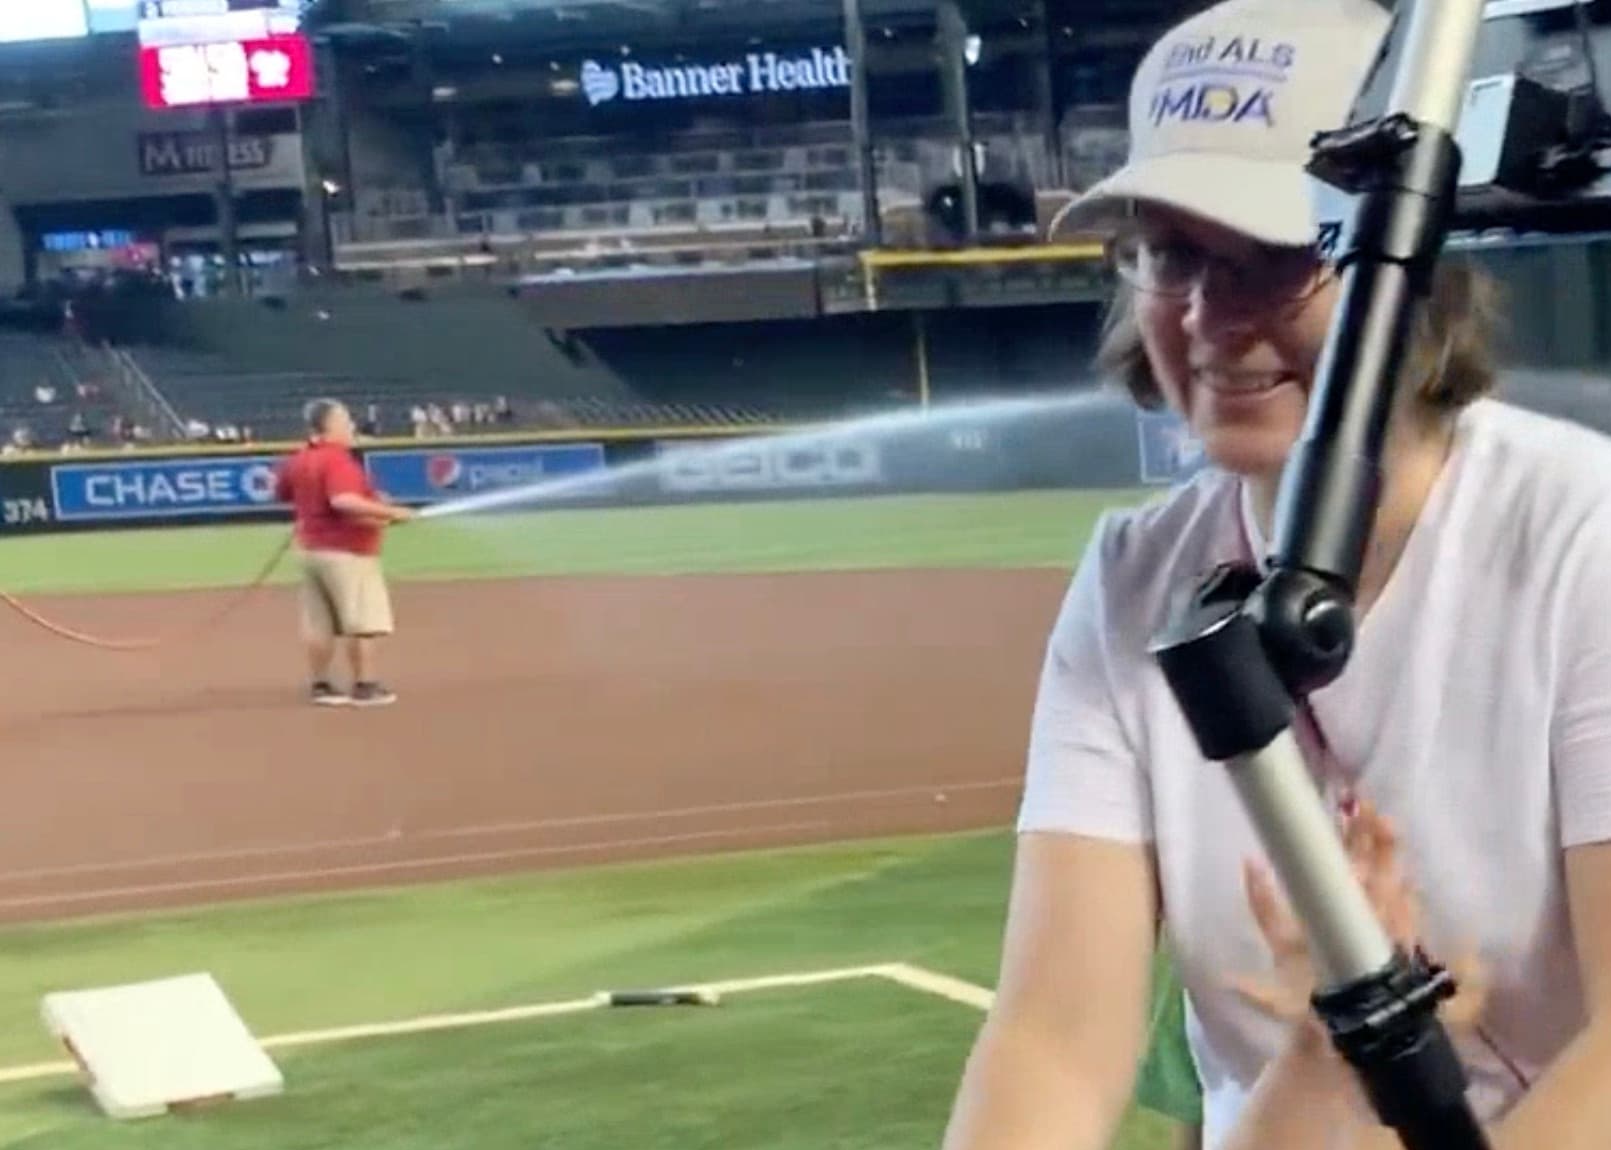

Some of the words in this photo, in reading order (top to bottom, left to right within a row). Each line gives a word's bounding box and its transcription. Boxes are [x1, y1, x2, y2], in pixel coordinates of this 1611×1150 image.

[1219, 35, 1296, 69] ALS
[621, 62, 744, 100] Banner
[1152, 85, 1276, 128] MDA
[85, 470, 239, 505] CHASE
